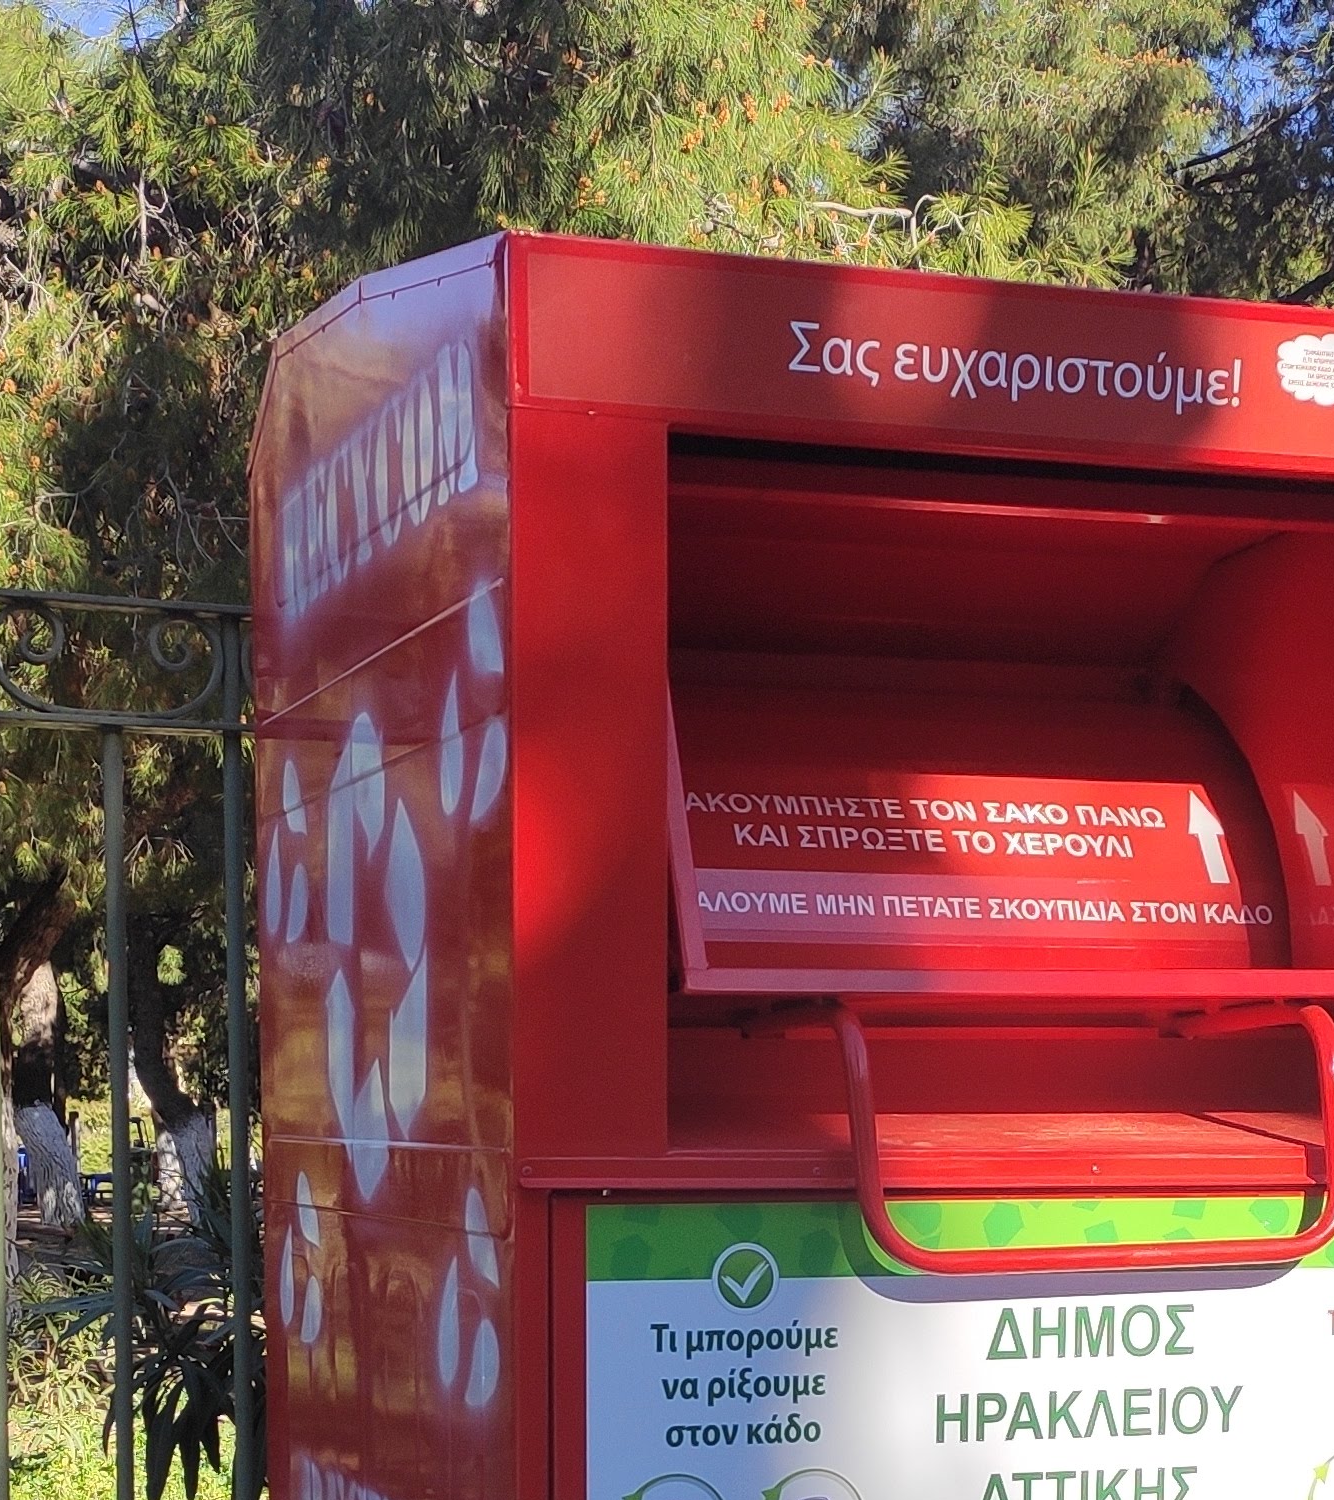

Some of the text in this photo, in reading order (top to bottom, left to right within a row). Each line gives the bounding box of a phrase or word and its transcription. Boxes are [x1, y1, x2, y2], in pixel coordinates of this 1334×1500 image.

[788, 320, 1243, 415] Σας ευχαριστούμε!
[685, 791, 1166, 829] ΑΚΟΥΜΠΗΣΤΕ ΤΟΝ ΣΑΚΟ ΠΑΝΩ
[733, 823, 1134, 859] ΚΑΙ ΣΠΡΩΞΤΕ ΤΟ ΧΕΡΟΥΛΙ
[815, 894, 875, 916] ΜΗΝ
[883, 895, 983, 919] ΠΕΤΑΤΕ
[989, 898, 1126, 923] ΣΚΟΥΠΙΔΙΑ
[1131, 901, 1198, 924] ΣΤΟΝ
[1203, 902, 1274, 925] ΚΑΔΟ
[650, 1319, 839, 1360] Τι μπορούμε
[985, 1303, 1195, 1360] ΔΗΜΟΣ
[661, 1367, 827, 1407] να ρίξουμε
[665, 1412, 822, 1448] στον κάδο
[935, 1385, 1244, 1443] ΗΡΑΚΛΕΙΟΥ
